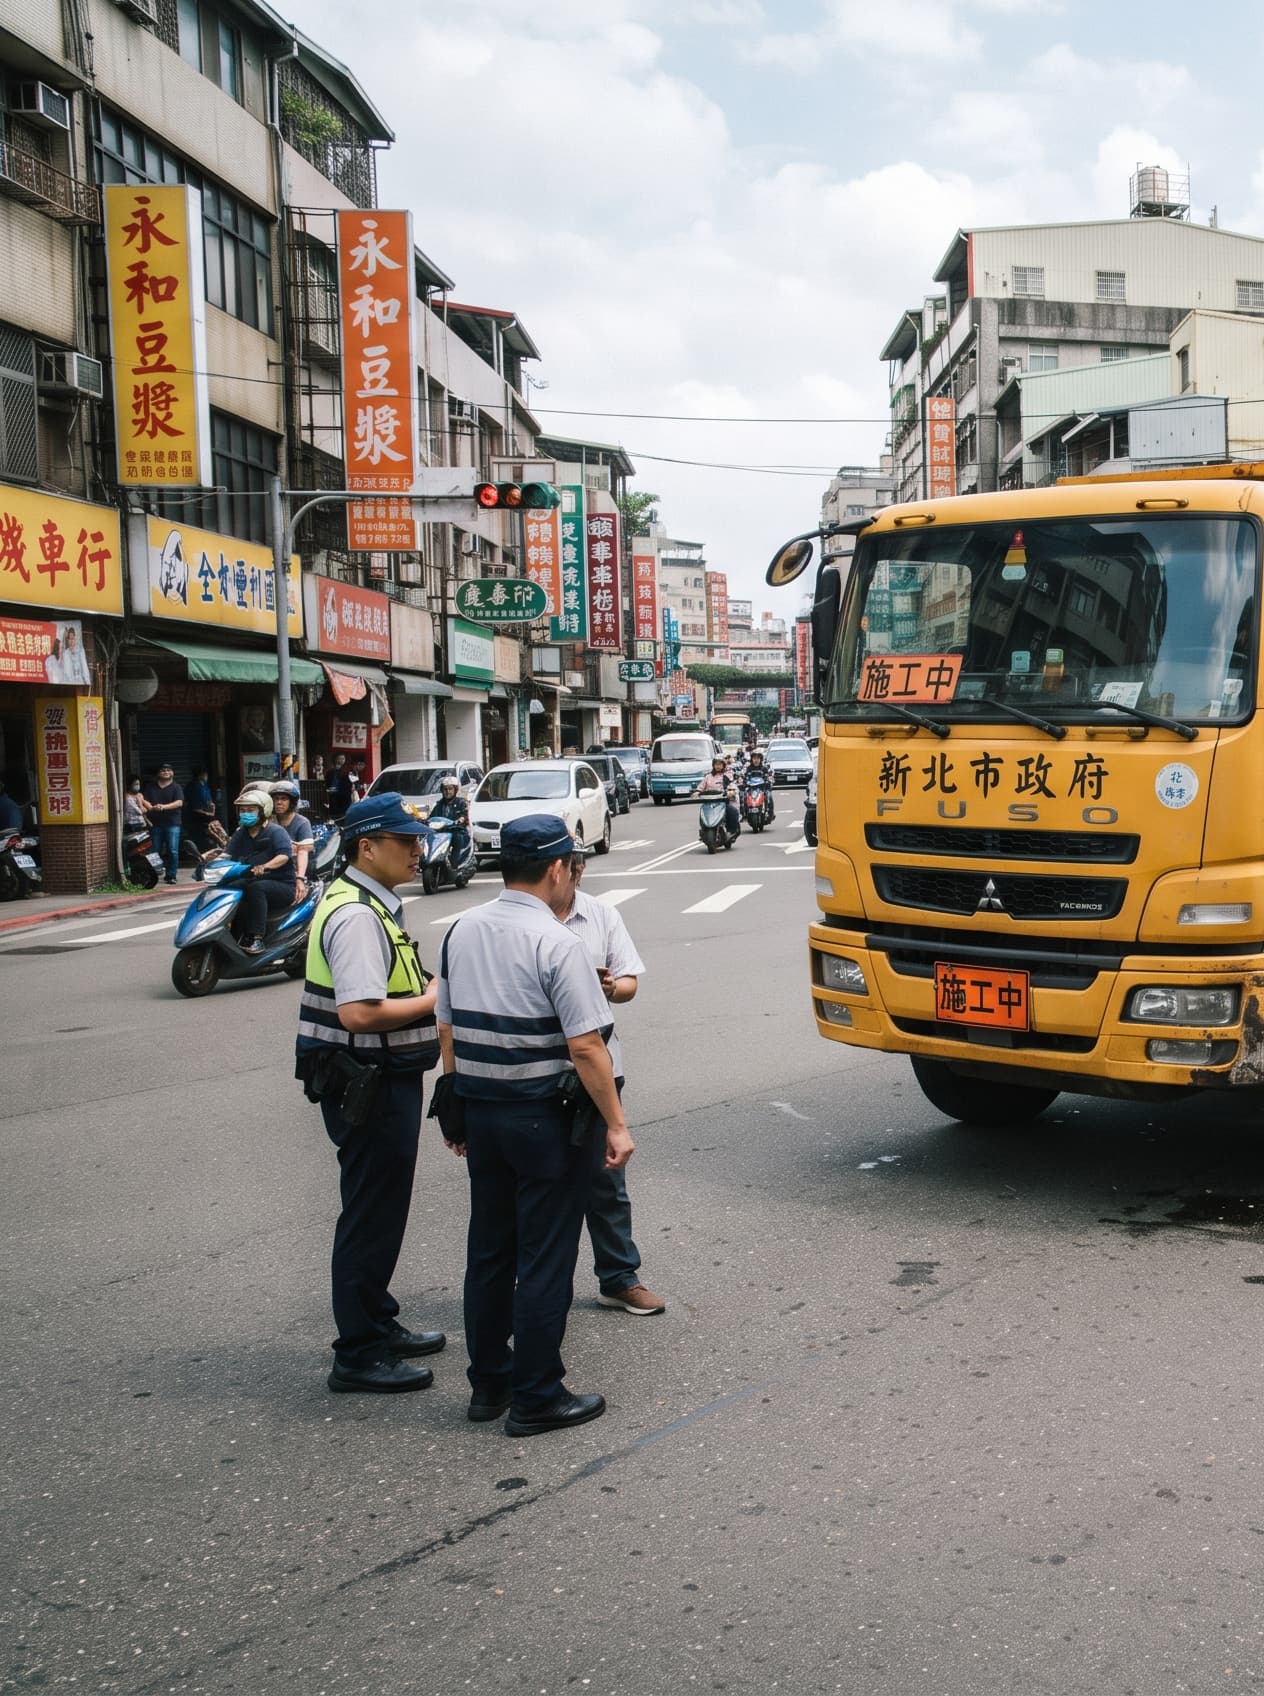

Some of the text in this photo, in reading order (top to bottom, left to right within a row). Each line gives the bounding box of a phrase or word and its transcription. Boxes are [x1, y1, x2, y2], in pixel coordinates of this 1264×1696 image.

[121, 196, 186, 440] 永和豆漿
[349, 219, 407, 466] 永和豆漿
[863, 659, 954, 700] 施工中
[879, 751, 1109, 800] 新北市政府
[876, 798, 1119, 825] FUSO
[940, 973, 1023, 1019] 施工中
